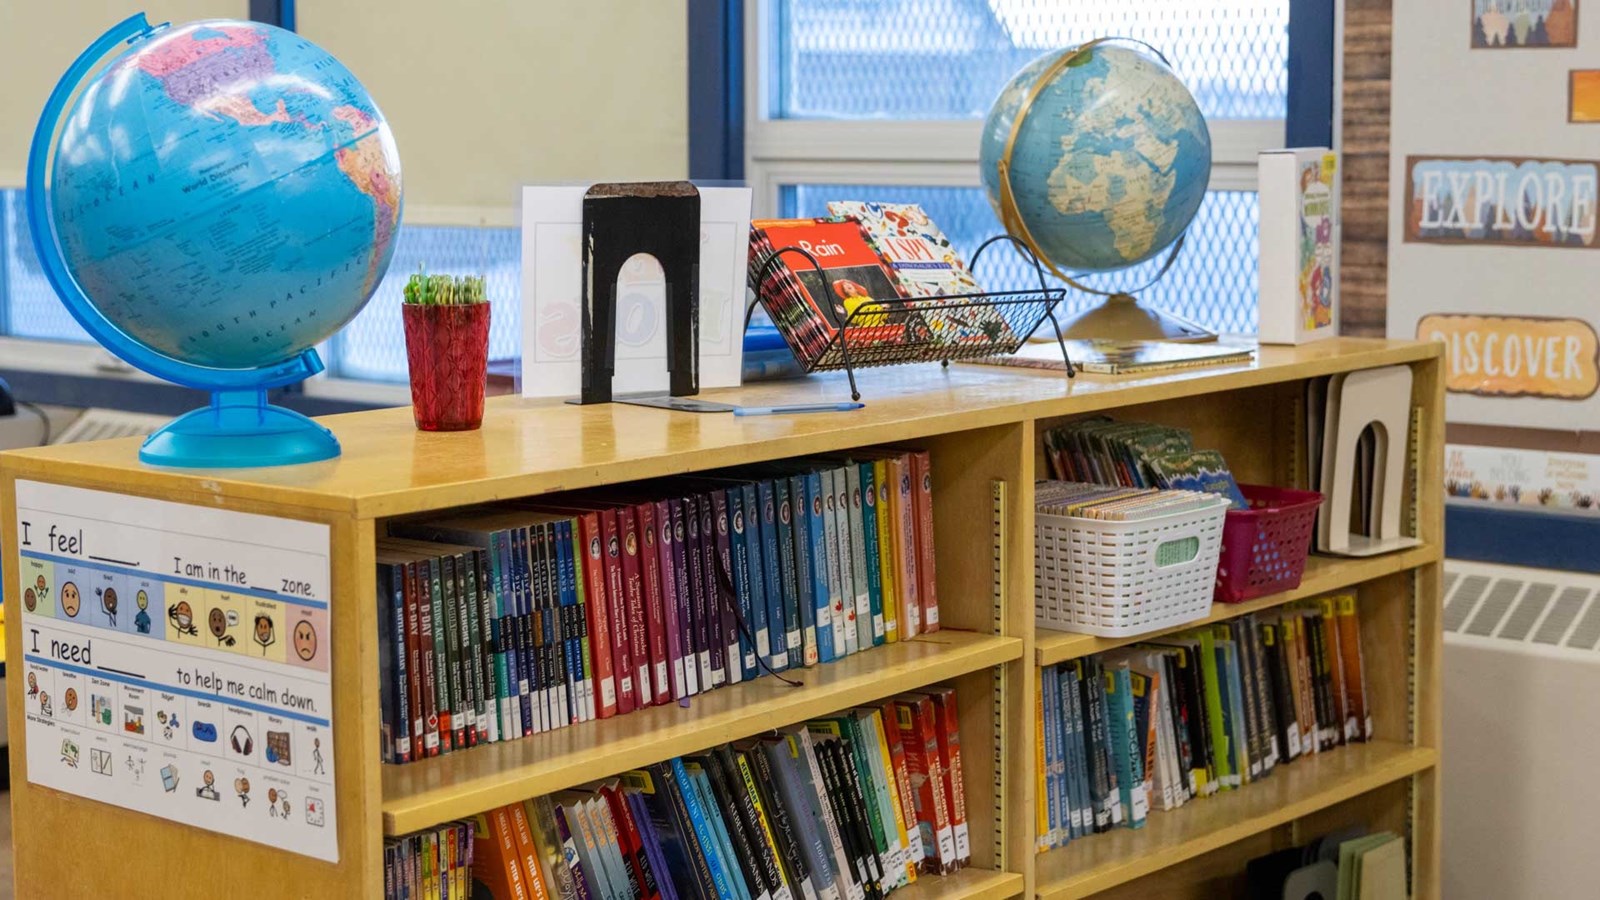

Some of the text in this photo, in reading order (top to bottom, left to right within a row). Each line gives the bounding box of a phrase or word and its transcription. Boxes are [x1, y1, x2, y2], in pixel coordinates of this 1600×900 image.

[181, 177, 208, 194] World
[209, 161, 250, 182] Discovery
[1419, 170, 1595, 234] EXPLORE
[798, 239, 845, 257] Rain
[884, 238, 935, 261] I SPY
[188, 256, 363, 343] SOUTH PACIFIC
[252, 309, 316, 343] OCEAN
[1430, 329, 1584, 381] ISCOVER
[22, 521, 83, 555] I feel
[174, 556, 315, 598] I am in the zone.
[533, 561, 541, 600] EVEREST
[550, 558, 558, 597] EVEREST
[567, 558, 575, 591] ISLAND
[397, 607, 405, 634] BATTLE
[409, 603, 419, 636] D-DAY
[420, 603, 432, 637] D-DAY
[433, 600, 444, 642] FLYING ACE
[460, 603, 470, 647] TRENCHES
[470, 591, 479, 633] FLYING ACE
[484, 599, 492, 642] TRENCHES
[31, 628, 91, 665] I need
[398, 642, 406, 671] BRITAIN
[574, 640, 582, 677] SHIPWRECK
[632, 625, 640, 657] Christmas
[176, 667, 317, 713] to help me calm down.
[26, 714, 38, 723] More
[740, 761, 758, 804] KEVIN HART
[901, 760, 918, 825] THE EXPLORER
[698, 824, 713, 857] AGAINST
[709, 858, 718, 871] ALL
[715, 872, 728, 896] ODDS
[729, 802, 744, 835] REBEL
[749, 856, 765, 894] SANDS
[744, 795, 758, 829] REBEL
[761, 849, 780, 887] SANDS
[510, 859, 520, 882] PETER
[526, 854, 544, 898] PETER LEE'S
[629, 875, 641, 894] WOLF
[644, 870, 656, 889] WOLF
